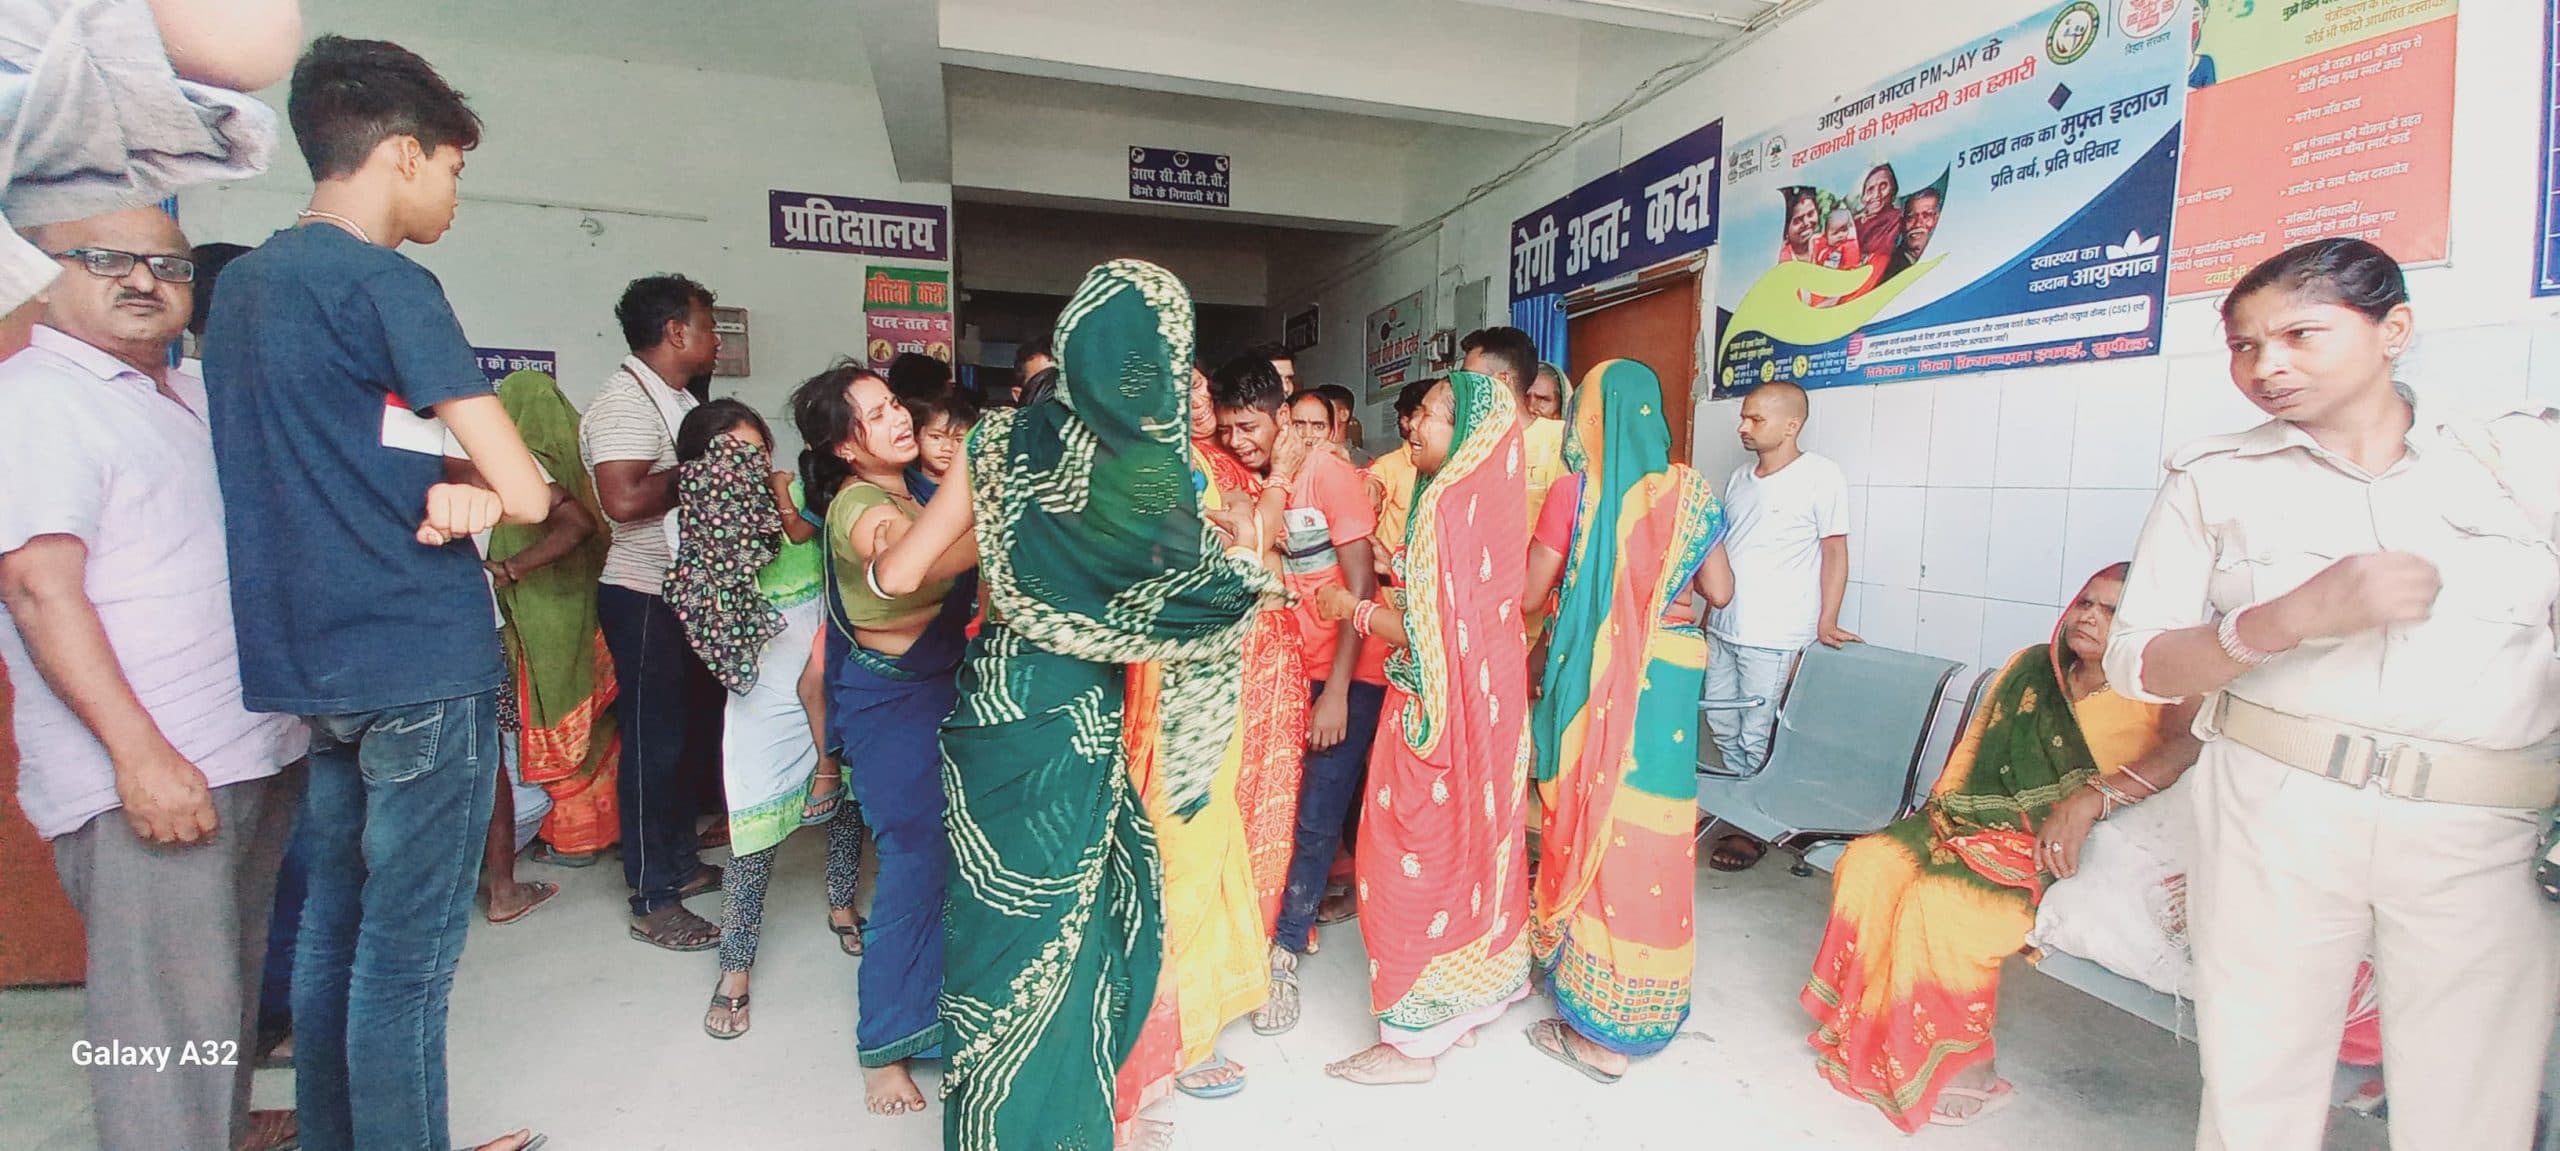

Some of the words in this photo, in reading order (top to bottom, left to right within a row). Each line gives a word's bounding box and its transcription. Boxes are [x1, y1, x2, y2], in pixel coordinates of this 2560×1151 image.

[1817, 94, 1875, 131] आयुष्मान
[1879, 77, 1916, 104] भारत
[1920, 48, 1978, 88] PM-JAY
[1982, 38, 2002, 62] के
[1792, 149, 1808, 168] हर
[1810, 125, 1856, 160] लाभार्थी
[1859, 118, 1878, 141] की
[1953, 81, 1983, 106] अब
[1986, 56, 2037, 94] हमारी
[1958, 151, 1965, 168] 5
[1970, 137, 2008, 165] लाख
[2010, 132, 2035, 151] तक
[2038, 125, 2057, 142] का
[2110, 84, 2170, 123] इलाज
[1132, 167, 1156, 181] आप
[1991, 165, 2013, 192] प्रति
[2016, 157, 2039, 179] वर्ष,
[2045, 149, 2069, 176] प्रति
[2073, 139, 2121, 164] परिवार
[781, 197, 938, 252] प्रतिक्षालय
[1514, 213, 1559, 295] रोगी
[1644, 155, 1715, 245] कक्ष
[2029, 276, 2068, 292] वरदान
[2071, 255, 2160, 288] आयुष्मान
[2031, 250, 2079, 270] स्वास्थ्य
[2080, 246, 2101, 260] का
[934, 319, 948, 331] न
[486, 354, 506, 370] को
